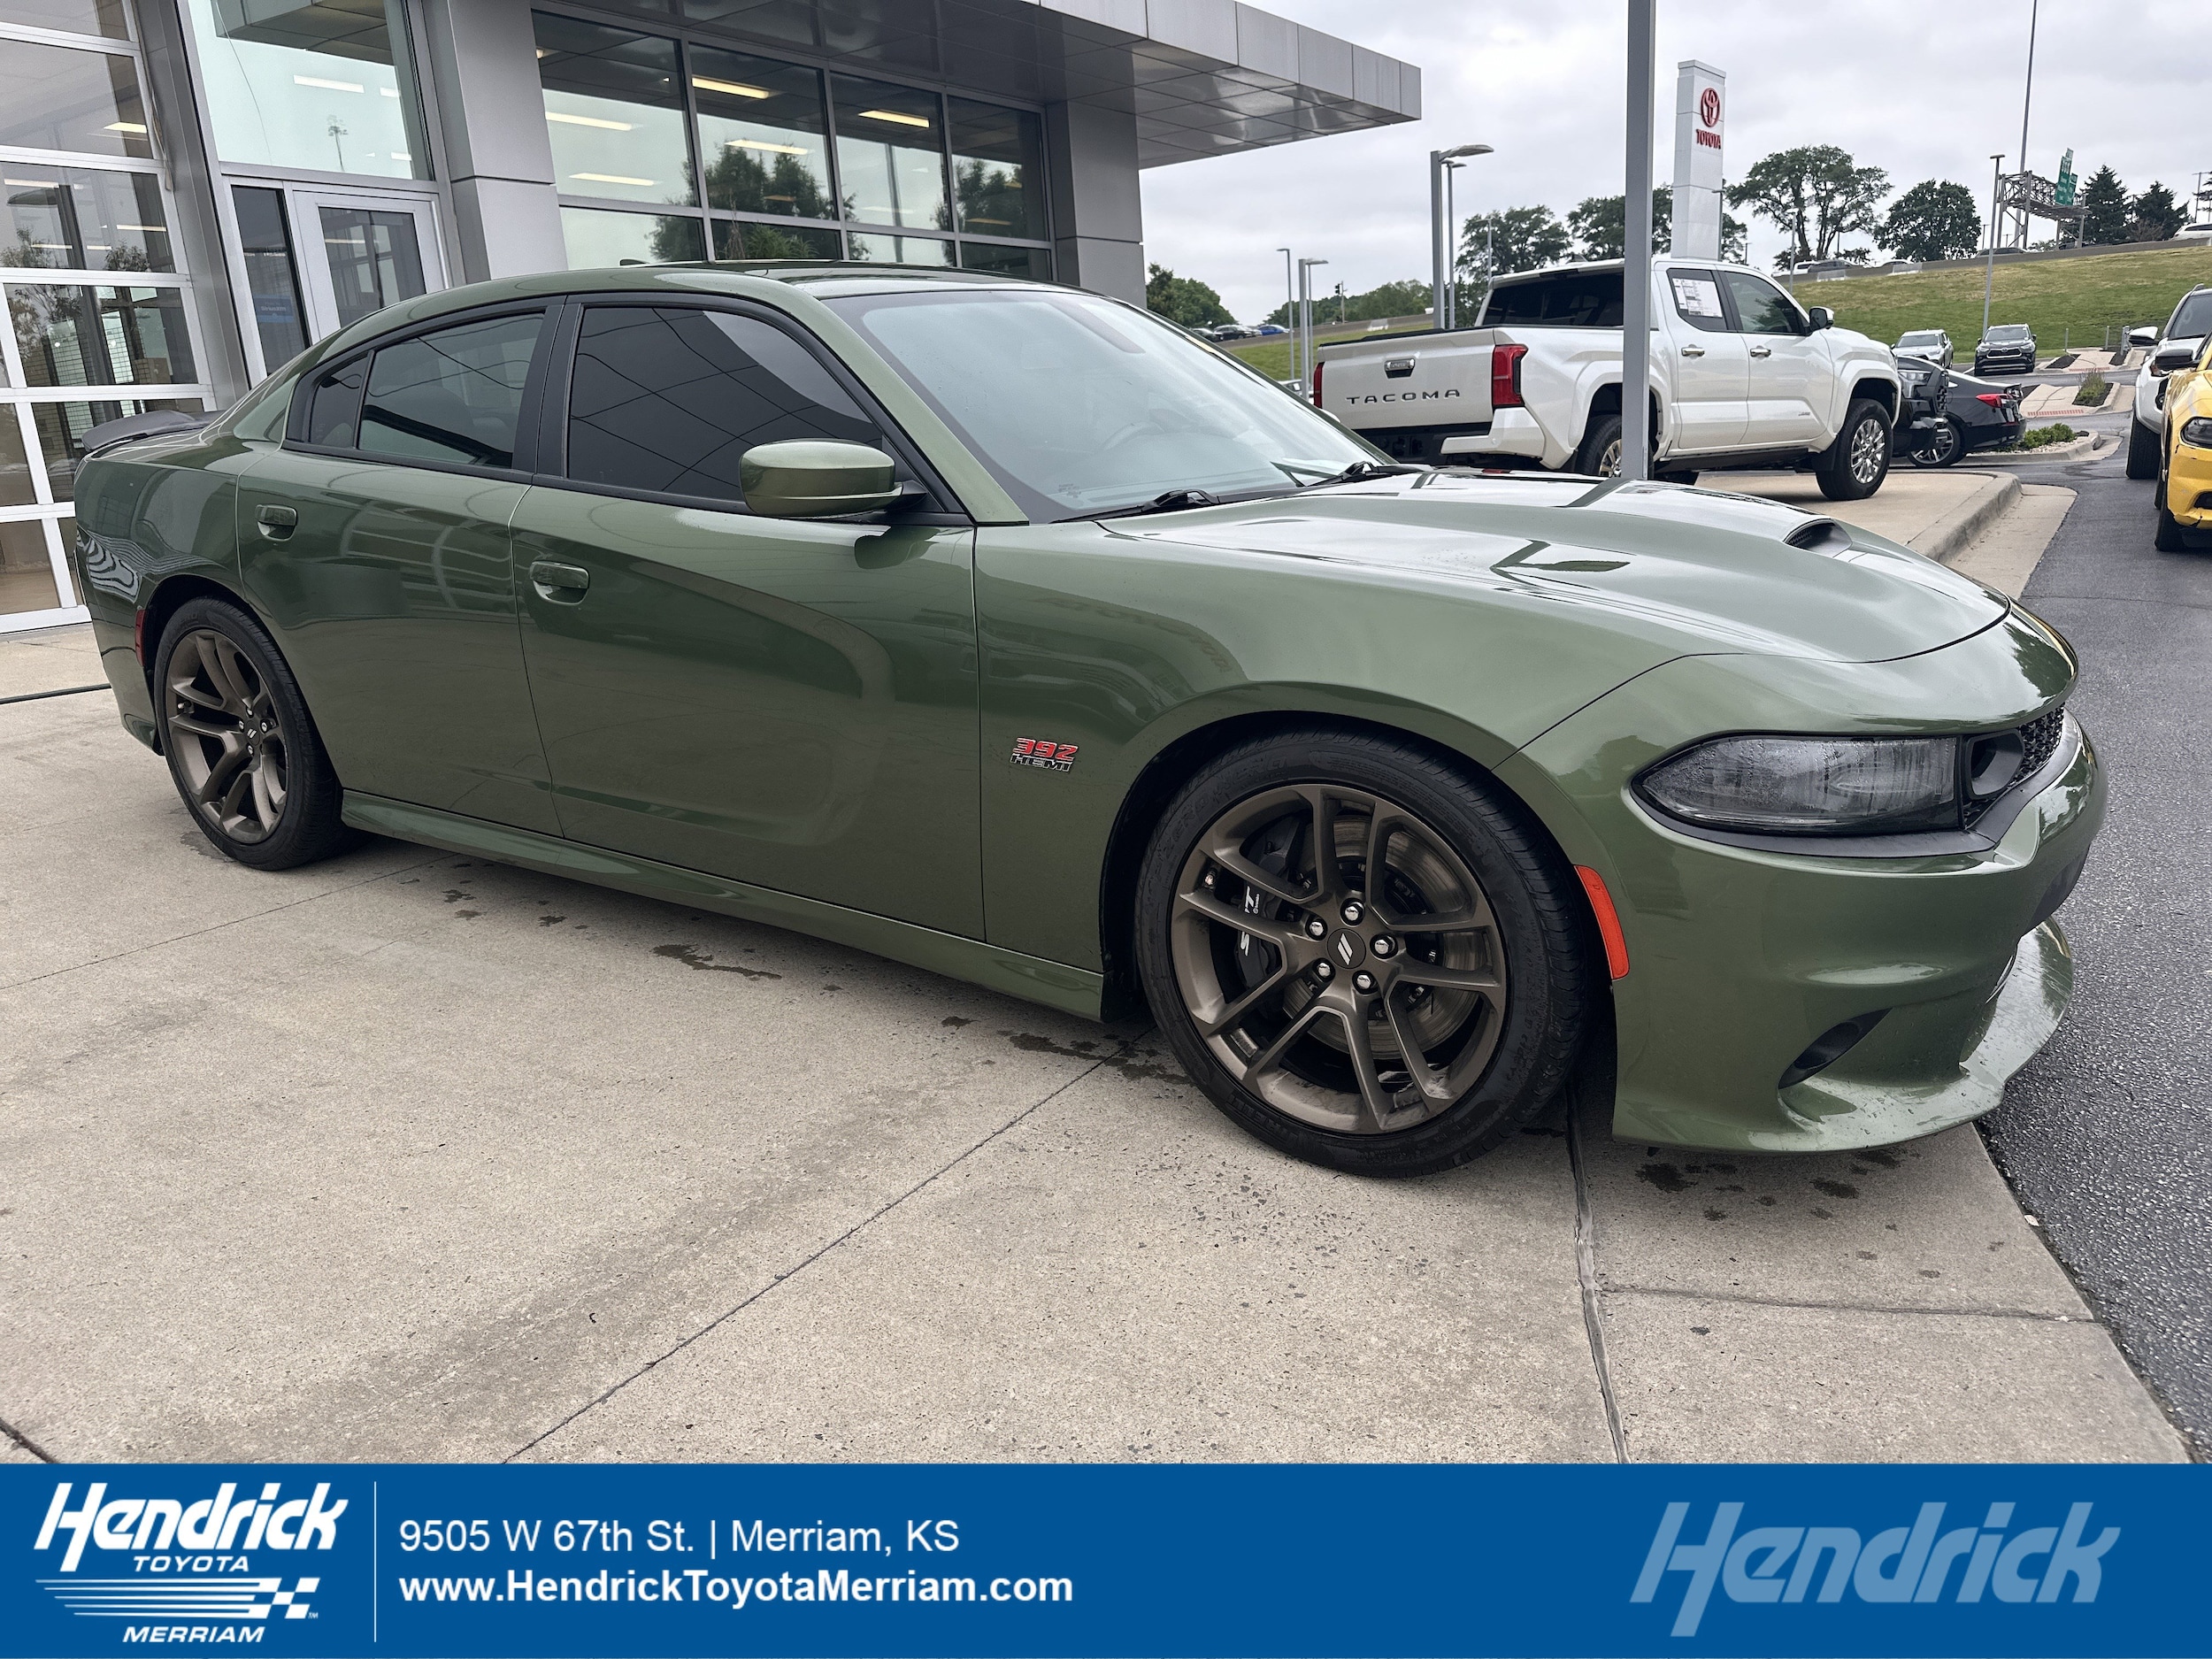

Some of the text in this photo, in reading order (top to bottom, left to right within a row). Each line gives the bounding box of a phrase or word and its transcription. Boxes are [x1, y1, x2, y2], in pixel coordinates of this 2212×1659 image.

[1695, 128, 1722, 150] TOYOTA
[1345, 388, 1461, 405] TACOMA
[1012, 737, 1079, 762] 392
[1010, 753, 1072, 772] HEMI
